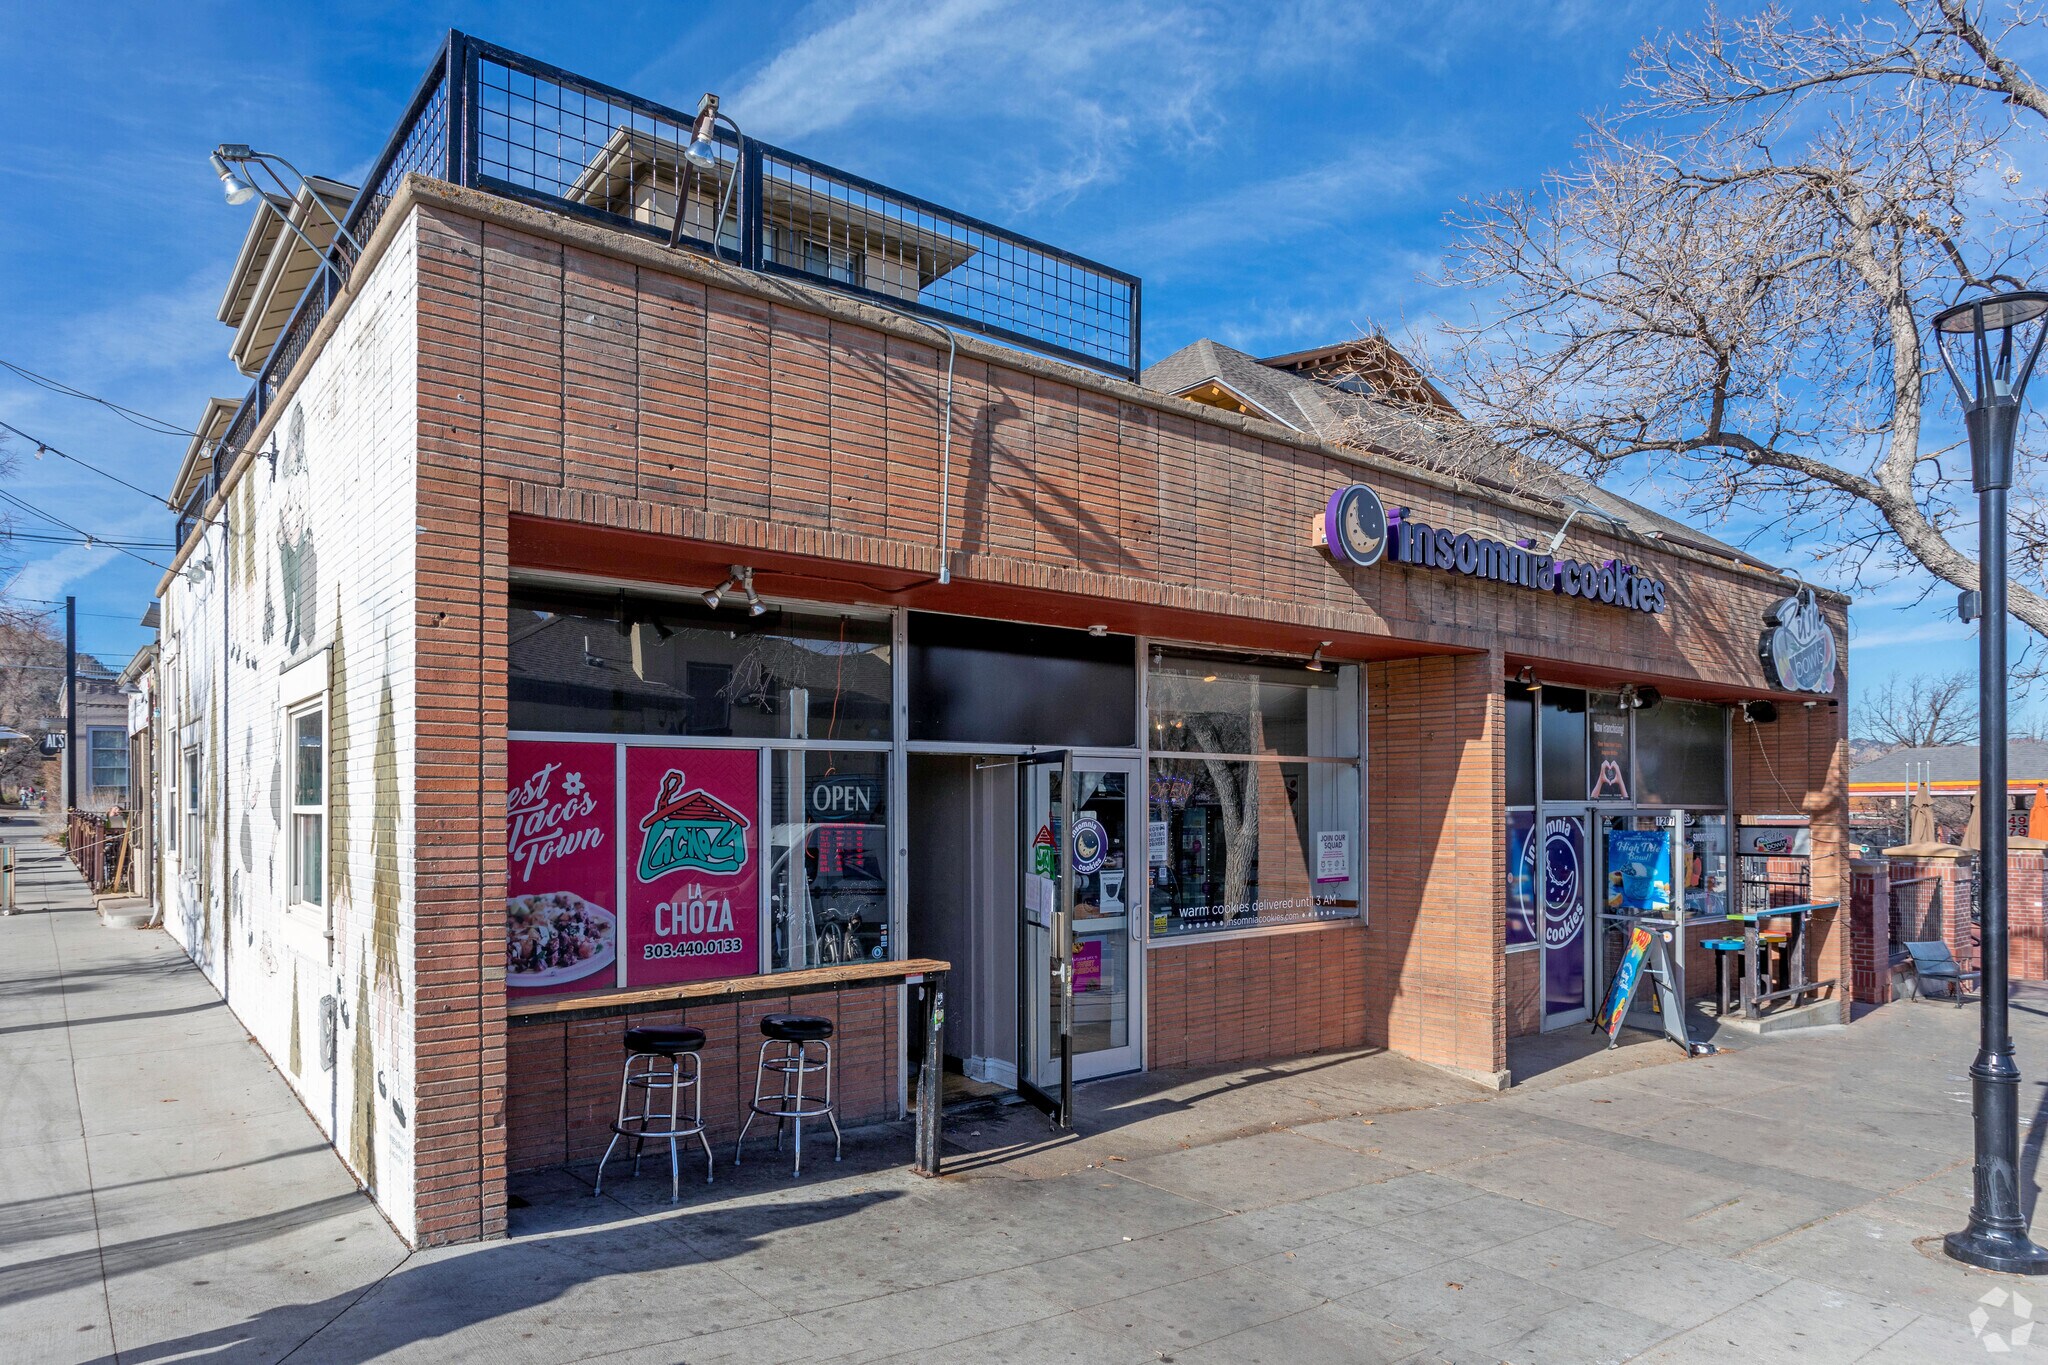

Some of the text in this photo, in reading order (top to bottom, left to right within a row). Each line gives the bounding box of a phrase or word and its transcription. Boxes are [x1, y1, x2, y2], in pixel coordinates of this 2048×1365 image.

[1397, 506, 1666, 614] insomnia cookies
[46, 733, 65, 748] AL'S
[507, 762, 562, 812] est
[812, 784, 871, 812] OPEN
[1149, 781, 1193, 798] OPEN
[507, 791, 598, 854] Tacos
[1655, 816, 1676, 827] 1207
[513, 826, 605, 882] Town
[1324, 842, 1343, 850] SQUAD
[1617, 841, 1640, 853] High
[1078, 857, 1102, 872] cookies
[688, 884, 703, 900] LA
[655, 898, 734, 937] CHOZA
[1179, 894, 1337, 918] warm cookies delivered until 3 AM
[1226, 912, 1300, 927] insomniacookies.com
[1546, 902, 1584, 941] cookies
[643, 937, 743, 960] 303.440.0133
